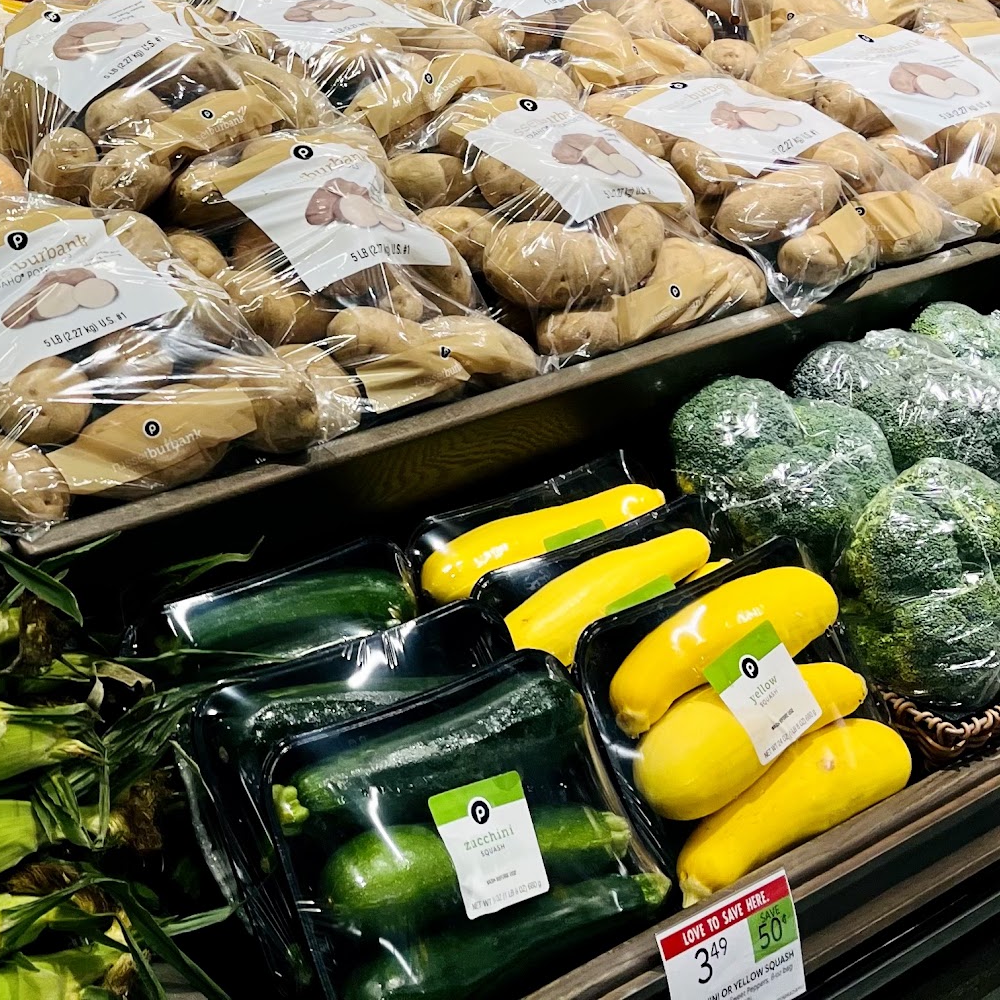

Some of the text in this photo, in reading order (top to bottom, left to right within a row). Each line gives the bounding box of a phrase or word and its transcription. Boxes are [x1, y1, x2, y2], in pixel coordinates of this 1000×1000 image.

[358, 249, 368, 259] LB
[43, 338, 52, 348] 5
[52, 333, 64, 345] LB
[64, 327, 84, 344] (2.27
[84, 321, 100, 338] kg)
[100, 316, 115, 329] U.S.
[749, 675, 778, 706] yellow
[759, 689, 779, 708] SQUASH
[463, 824, 515, 851] zucchini
[480, 843, 505, 857] SQUASH
[682, 890, 770, 946] LOVE TO SAVE HERE.
[760, 904, 780, 923] SAVE
[721, 985, 733, 998] OR
[733, 965, 764, 990] YELLOW
[764, 950, 795, 974] SQUASH
[782, 963, 794, 976] bag
